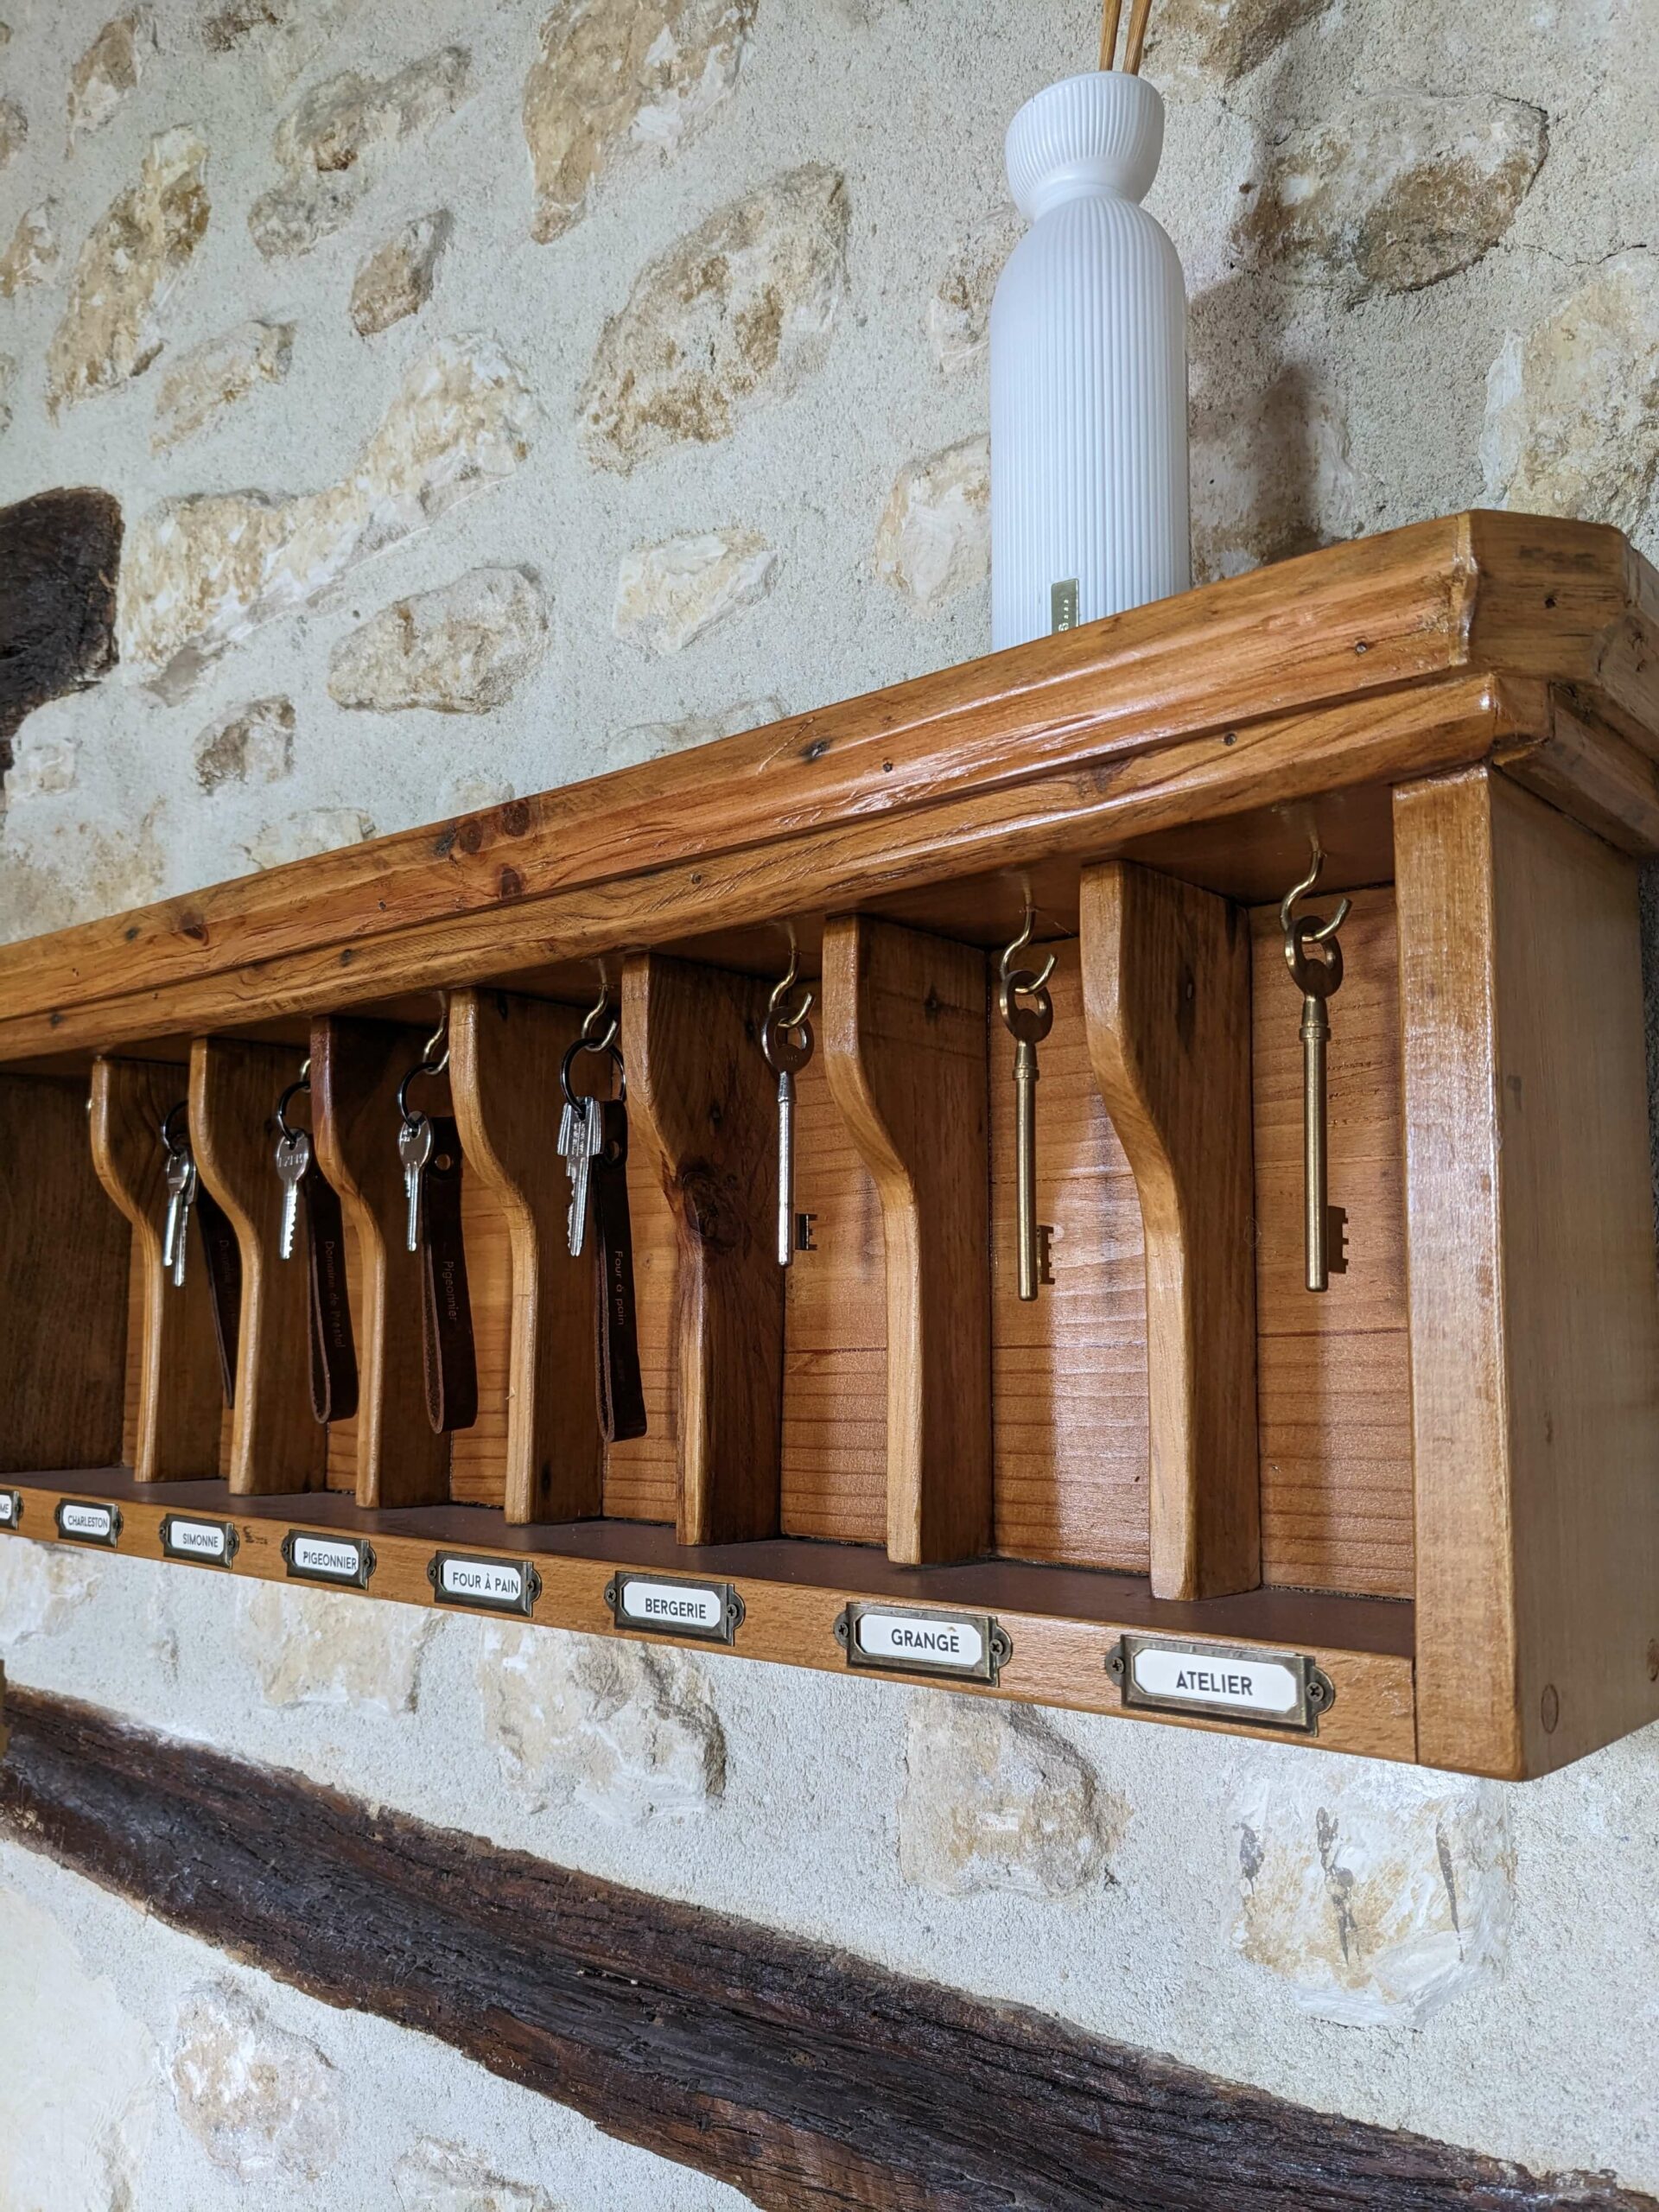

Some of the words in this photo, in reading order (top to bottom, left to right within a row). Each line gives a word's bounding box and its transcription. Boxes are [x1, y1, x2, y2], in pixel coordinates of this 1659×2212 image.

[614, 1250, 623, 1278] Four
[442, 1261, 459, 1321] Pigeonnier
[615, 1298, 626, 1325] pain
[67, 1515, 108, 1529] CHARLESTON
[182, 1533, 219, 1548] SIMONNE
[302, 1552, 357, 1570] PIGEONNIER
[452, 1572, 481, 1589] FOUR
[484, 1573, 493, 1591] À
[494, 1577, 519, 1594] PAIN
[645, 1598, 707, 1619] BERGERIE
[890, 1628, 960, 1653] GRANGE
[1175, 1669, 1253, 1696] ATELIER
